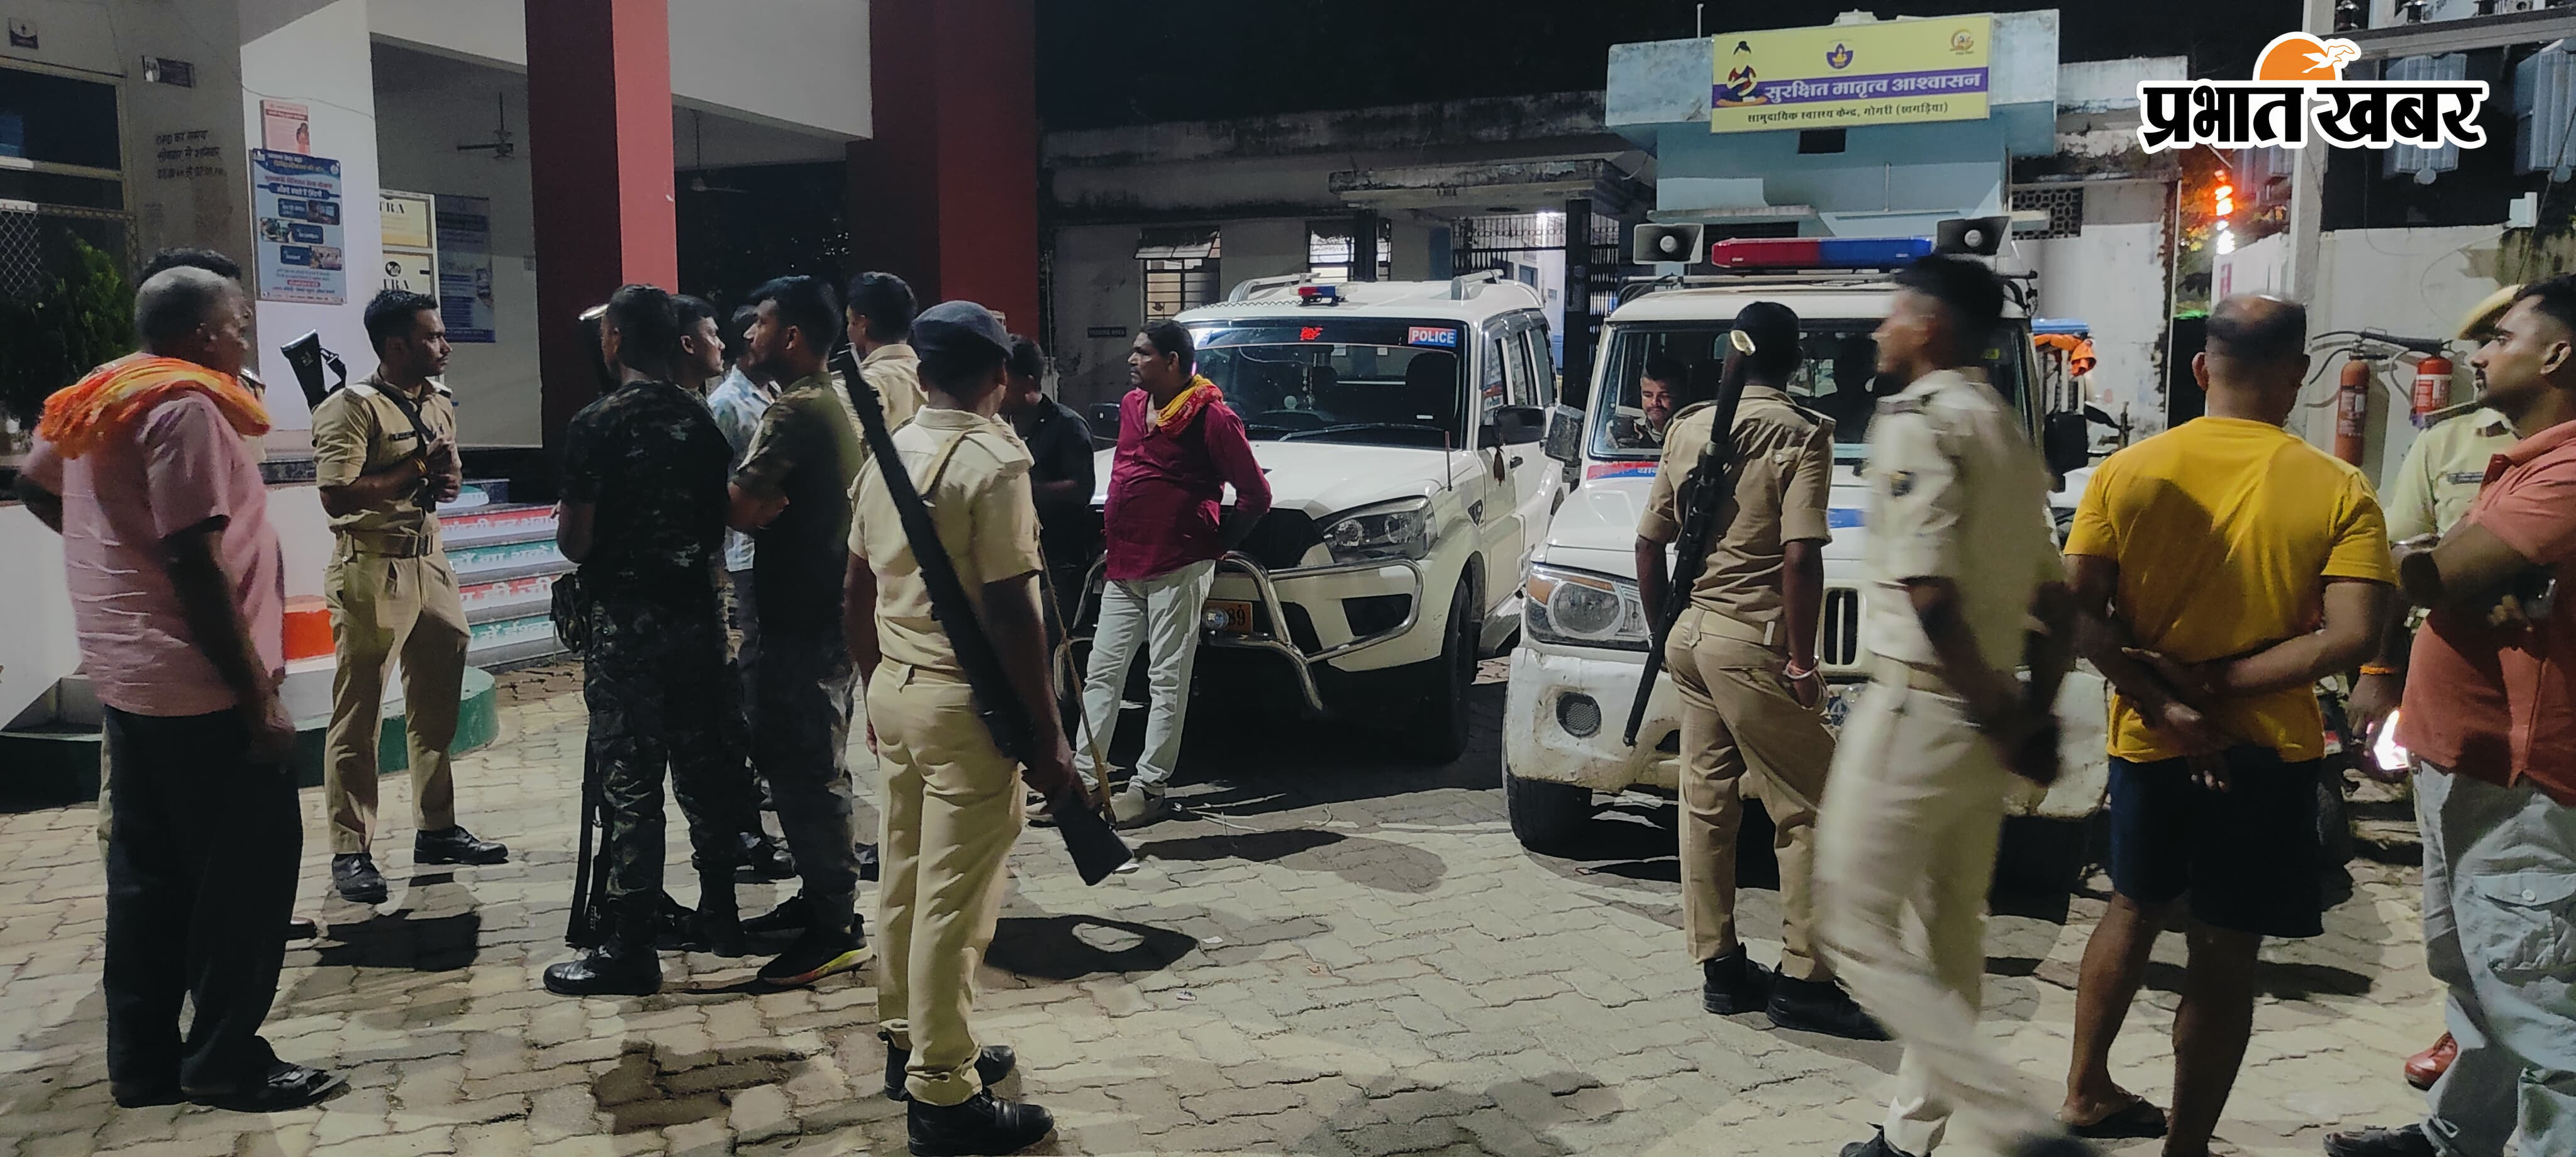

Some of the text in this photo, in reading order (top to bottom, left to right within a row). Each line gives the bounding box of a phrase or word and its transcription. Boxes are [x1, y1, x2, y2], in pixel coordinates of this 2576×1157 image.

[1765, 72, 1982, 103] सुरक्षित मातृत्व आश्वासन
[1747, 111, 1798, 124] सामुदायिक
[1411, 329, 1455, 344] POLICE
